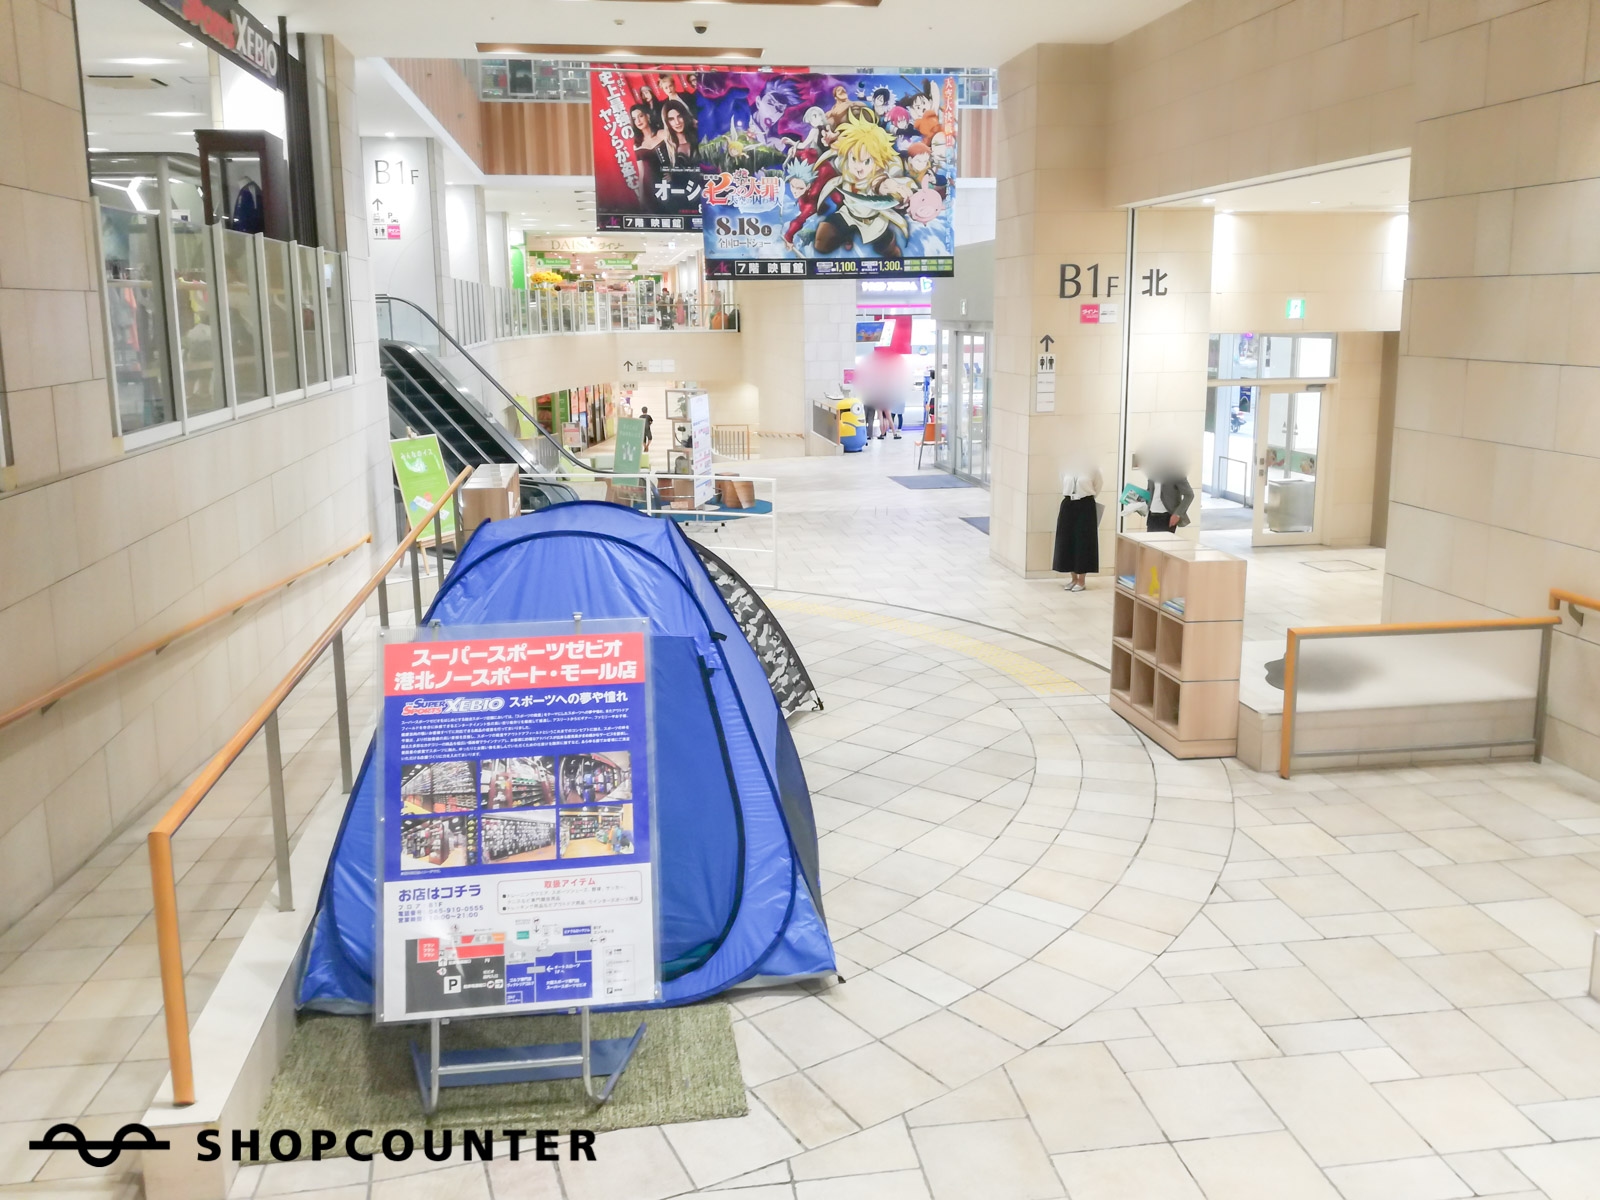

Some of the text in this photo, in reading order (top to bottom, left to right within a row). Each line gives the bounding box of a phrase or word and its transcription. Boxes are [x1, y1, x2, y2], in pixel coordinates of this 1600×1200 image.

[234, 13, 278, 77] XEBIO
[598, 70, 635, 139] 史上最強の
[599, 108, 640, 190] ヤツらが盗む
[374, 160, 419, 185] B1F
[702, 172, 779, 206] 七つの大罪
[719, 238, 772, 249] 全国ロードショー
[738, 262, 760, 274] 7階
[768, 262, 804, 274] 映画館
[1059, 263, 1120, 299] B1F
[1142, 268, 1168, 296] 北
[411, 639, 623, 667] スーパースポーツゼビオ
[394, 660, 637, 691] 港北ノースポート・モール店
[442, 696, 505, 714] XEBIO
[509, 690, 628, 708] スポーツへの夢や憧れ
[398, 884, 482, 902] お店はコチラ
[544, 878, 596, 888] 取扱アイテム
